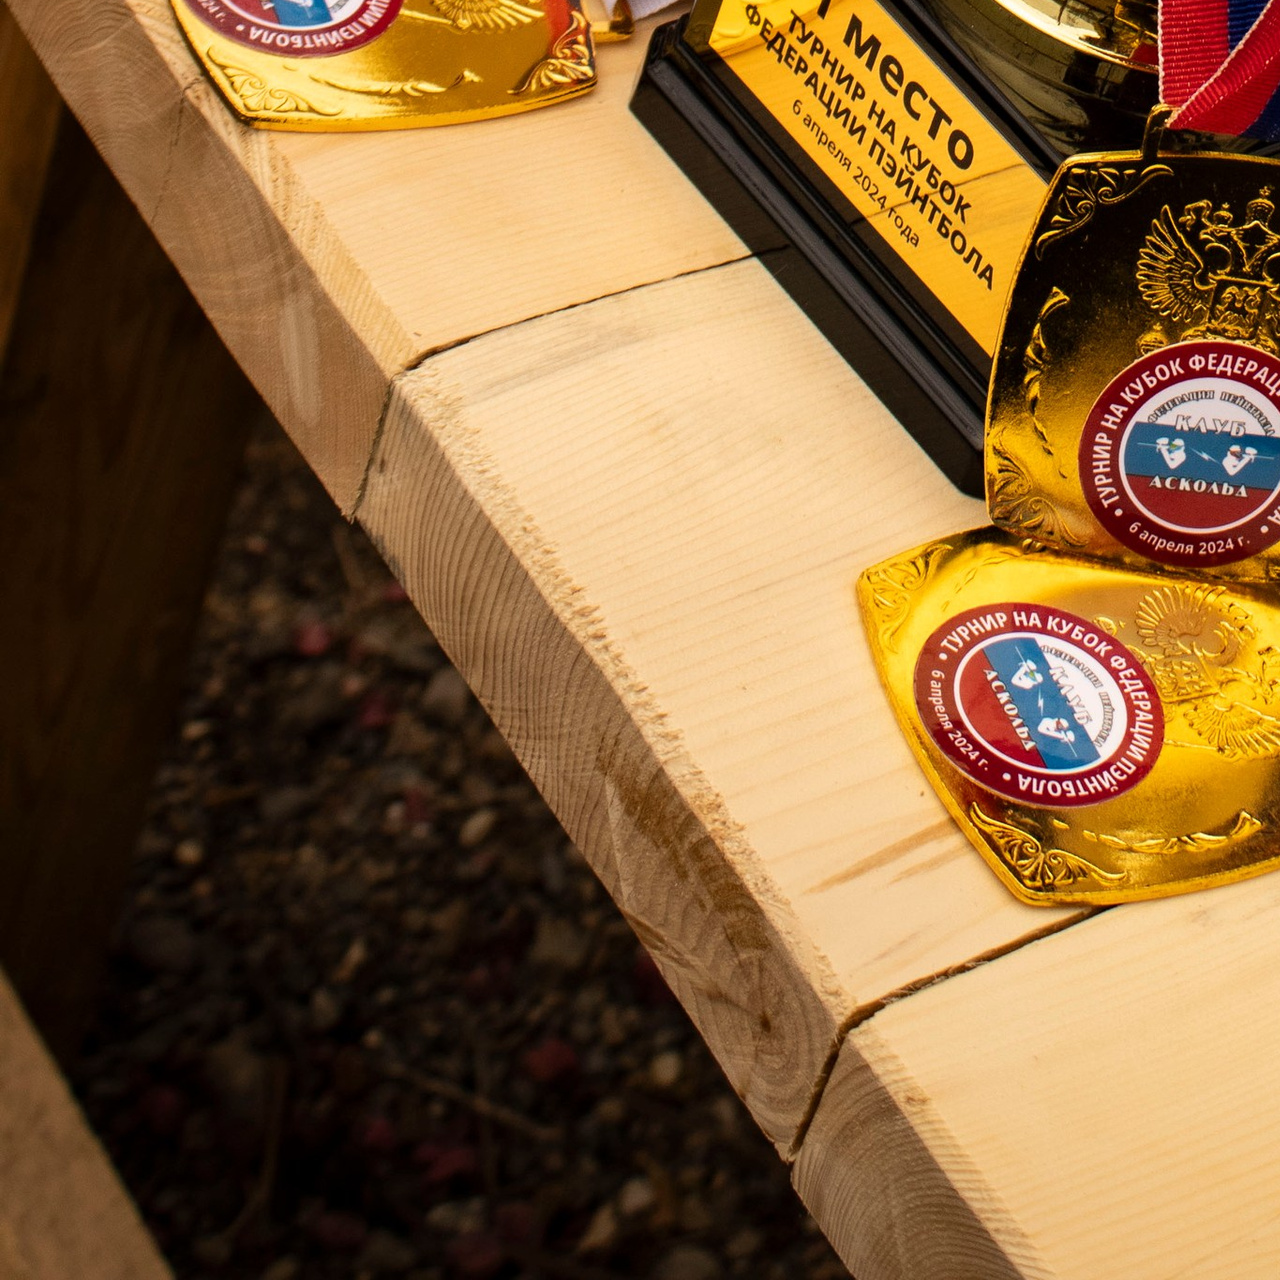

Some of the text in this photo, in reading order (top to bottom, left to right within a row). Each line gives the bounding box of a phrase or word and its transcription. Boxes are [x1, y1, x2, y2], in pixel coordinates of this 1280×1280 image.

[249, 17, 367, 48] ПЭЙНТБОЛА
[788, 9, 972, 224] ТУРНИР НА КУБОК
[843, 13, 974, 171] место
[745, 4, 867, 146] ФЕДЕРАЦИИ
[868, 137, 994, 290] ПЭЙНТБОЛА
[792, 99, 920, 248] 6 апреля 2024 года
[1103, 403, 1129, 431] НА
[1120, 357, 1185, 404] КУБОК
[1175, 414, 1248, 438] КЛУБ
[1093, 432, 1119, 509] ТУРНИР
[1128, 522, 1250, 555] 6 апреля 2024 г.
[928, 669, 989, 772] 6 апреля 2024 г.
[940, 611, 1154, 798] ТУРНИР НА КУБОК ФЕДЕРАЦИИ ПЭЙНТБОЛА
[1049, 666, 1093, 725] КЛУБ
